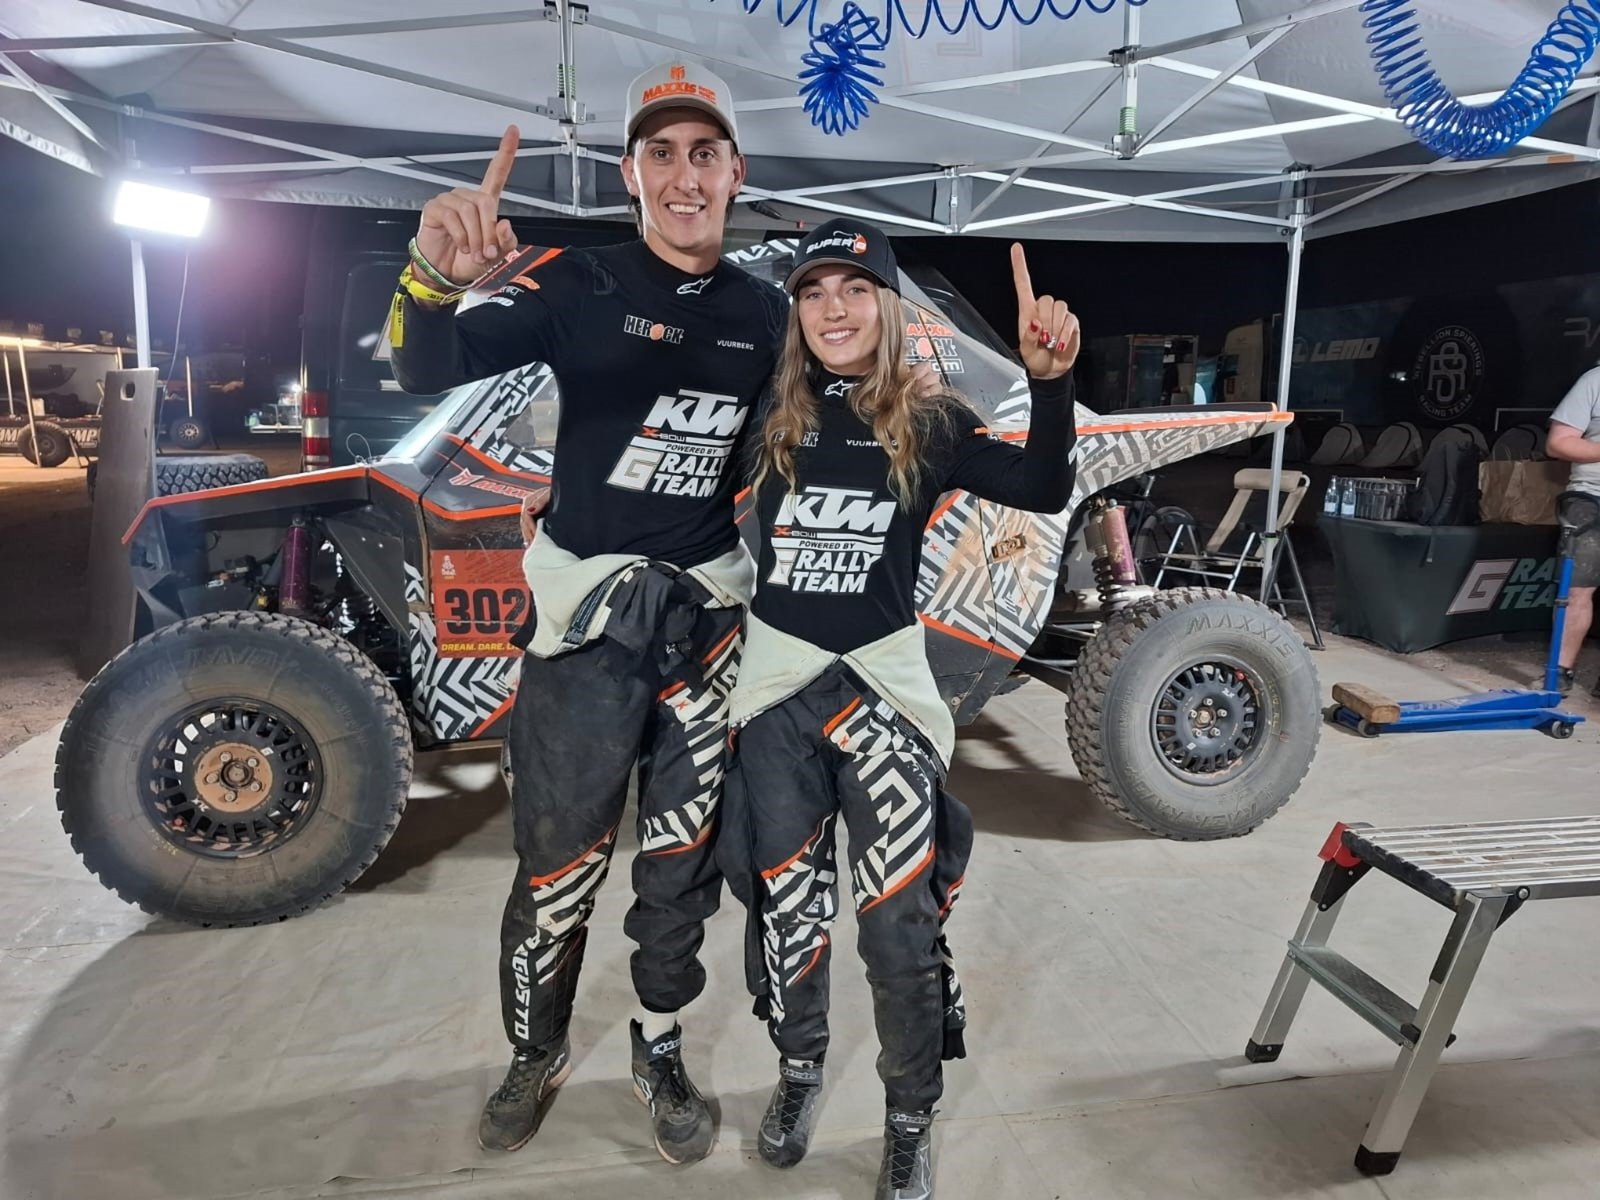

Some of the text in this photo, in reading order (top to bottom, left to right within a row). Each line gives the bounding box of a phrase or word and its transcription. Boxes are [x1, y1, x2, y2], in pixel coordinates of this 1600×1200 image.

[642, 82, 697, 104] MAXXIS
[806, 237, 852, 254] SUPER
[717, 339, 754, 351] VUURBERG
[1310, 337, 1381, 363] LEMO
[643, 388, 750, 437] KTM
[665, 443, 706, 455] POWERED
[846, 438, 899, 448] VUURBG
[659, 453, 728, 477] RALLY
[652, 473, 720, 497] TEAM
[774, 486, 897, 533] KTM
[799, 540, 840, 549] POWERED
[795, 550, 882, 572] RALLY
[1508, 558, 1557, 583] RA
[792, 571, 868, 593] TEAM
[1500, 584, 1555, 610] TEA
[444, 588, 526, 635] 302
[1186, 612, 1297, 658] MAXXIS
[441, 643, 476, 652] DREAM.
[478, 642, 505, 651] DARE.
